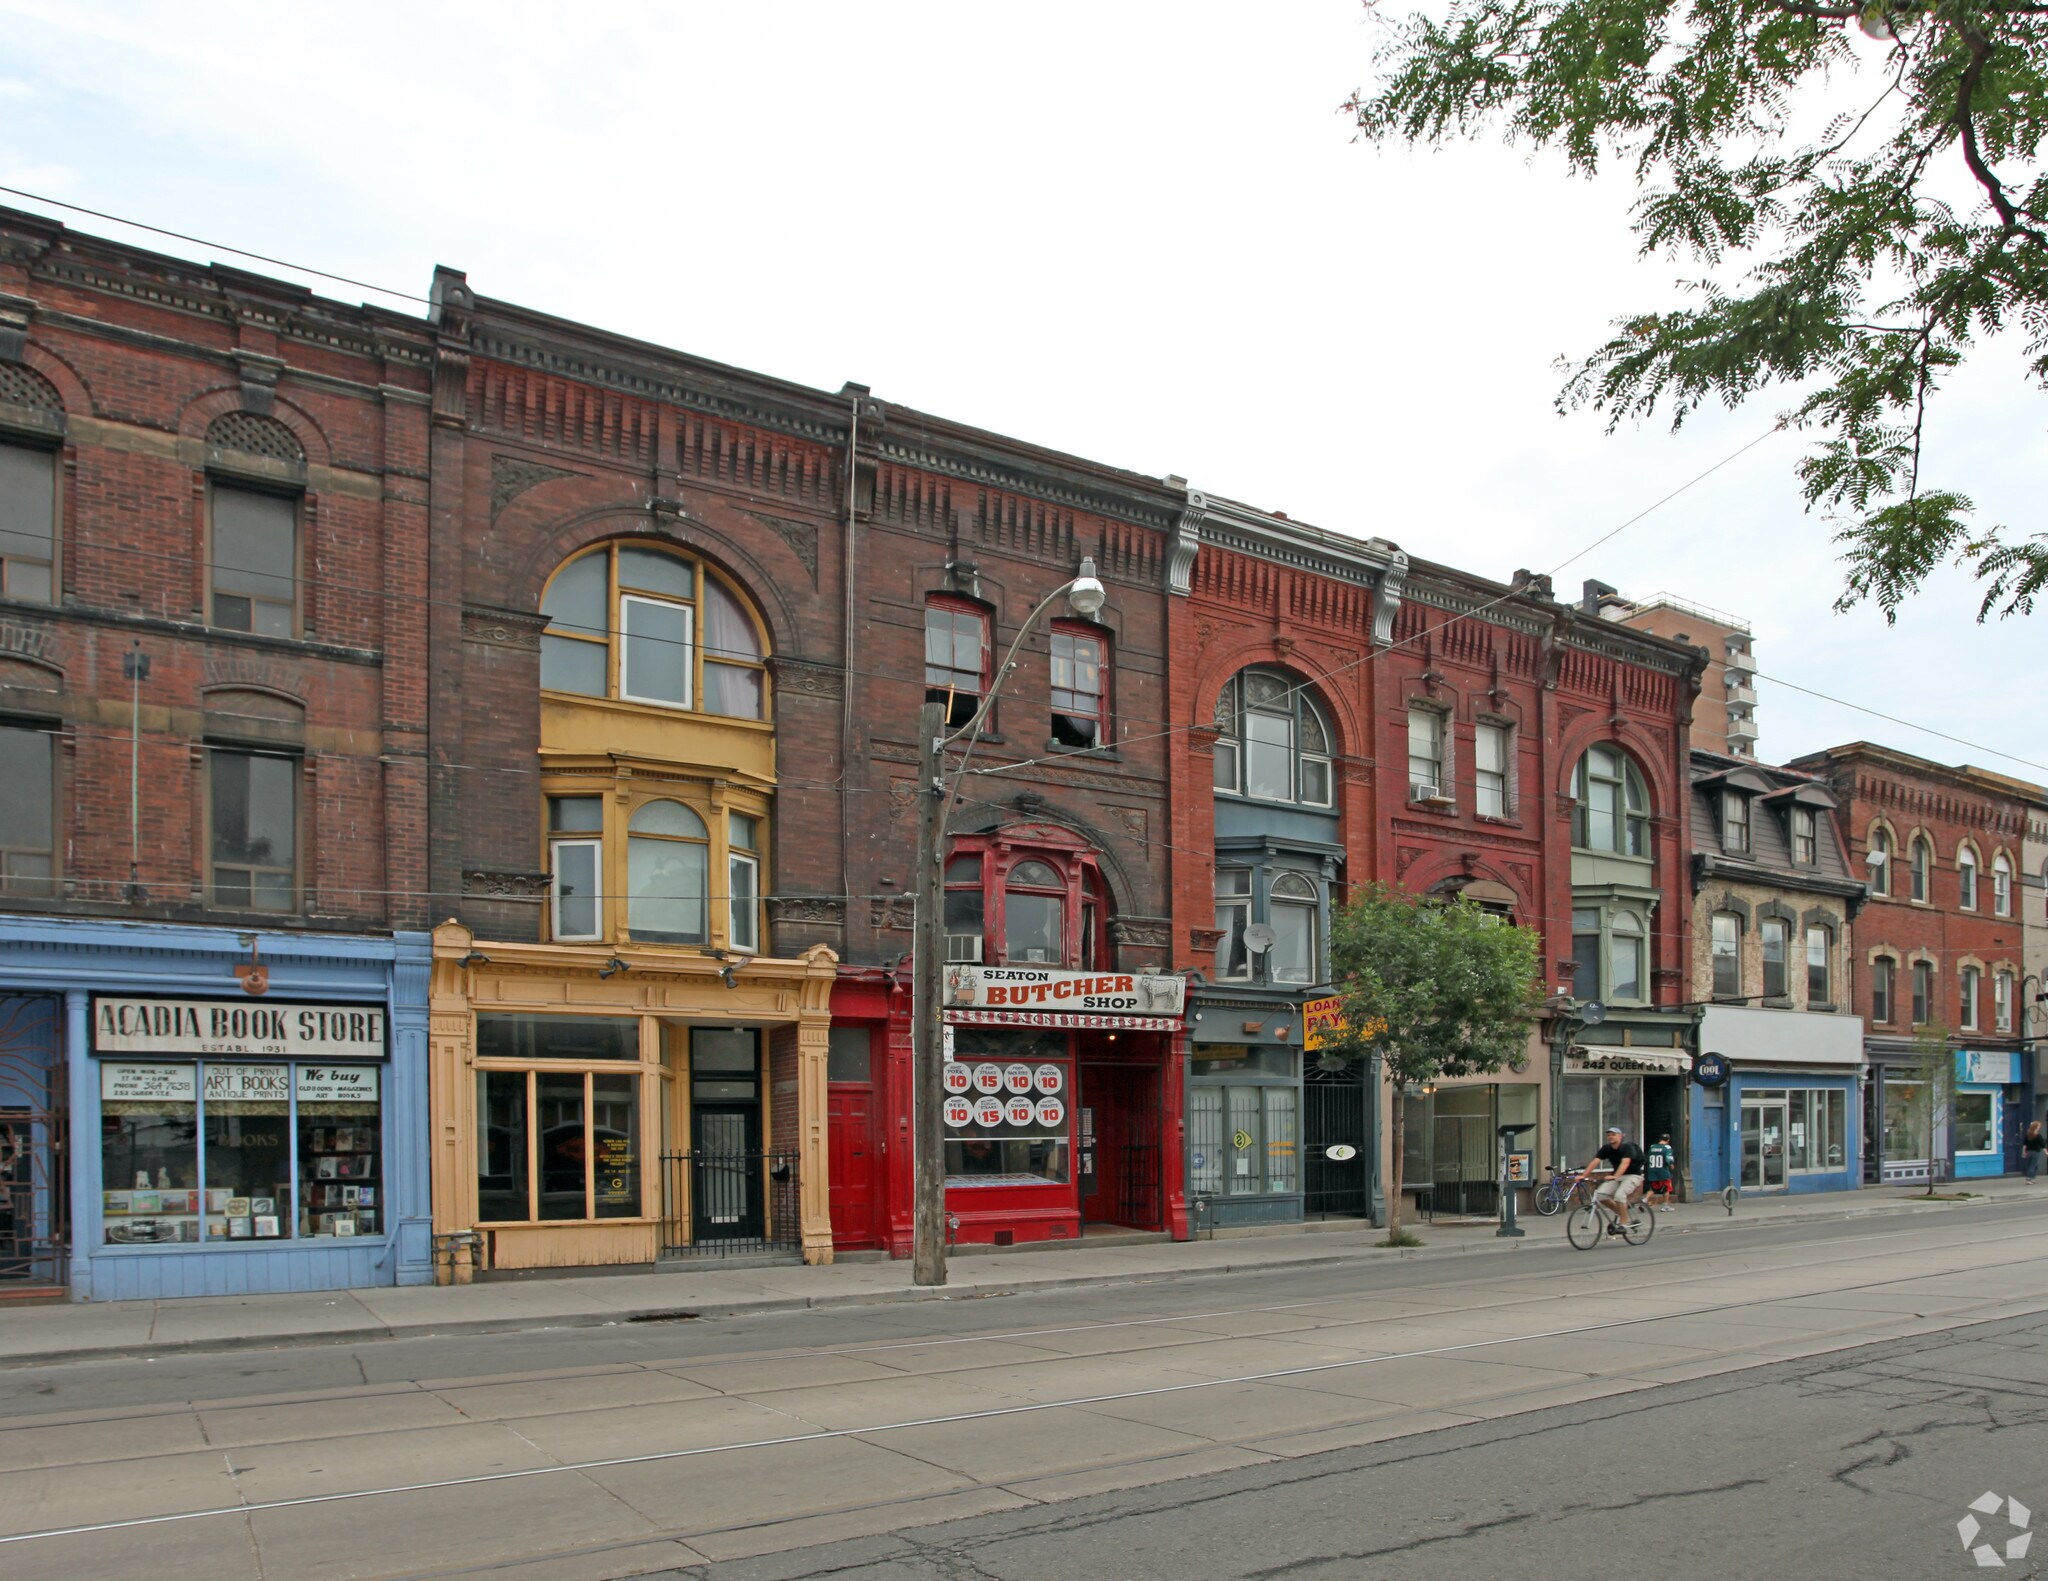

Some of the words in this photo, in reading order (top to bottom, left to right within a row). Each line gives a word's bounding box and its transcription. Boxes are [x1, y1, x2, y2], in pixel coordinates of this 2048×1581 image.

[983, 970, 1049, 982] SEATON
[986, 975, 1133, 1005] BUTCHER
[1083, 996, 1138, 1009] SHOP
[99, 1004, 201, 1038] ACADIA
[210, 1007, 288, 1040] BOOK
[298, 1010, 382, 1043] STORE
[996, 1012, 1056, 1025] SEATON
[1059, 1015, 1137, 1028] BUTCHERS
[201, 1044, 254, 1053] ESTABL.
[262, 1045, 287, 1054] 1931
[211, 1066, 231, 1075] OUT
[236, 1067, 248, 1075] OF
[253, 1067, 281, 1076] PRINT
[1582, 1061, 1606, 1070] 242
[1609, 1061, 1644, 1072] QUEEN
[305, 1068, 325, 1081] We
[330, 1069, 361, 1084] buy
[204, 1075, 234, 1090] ART
[241, 1076, 289, 1091] BOOKS
[208, 1090, 249, 1098] ANTIQUE
[253, 1090, 285, 1099] PRINTS
[1649, 1154, 1664, 1169] 90
[611, 1178, 623, 1189] G
